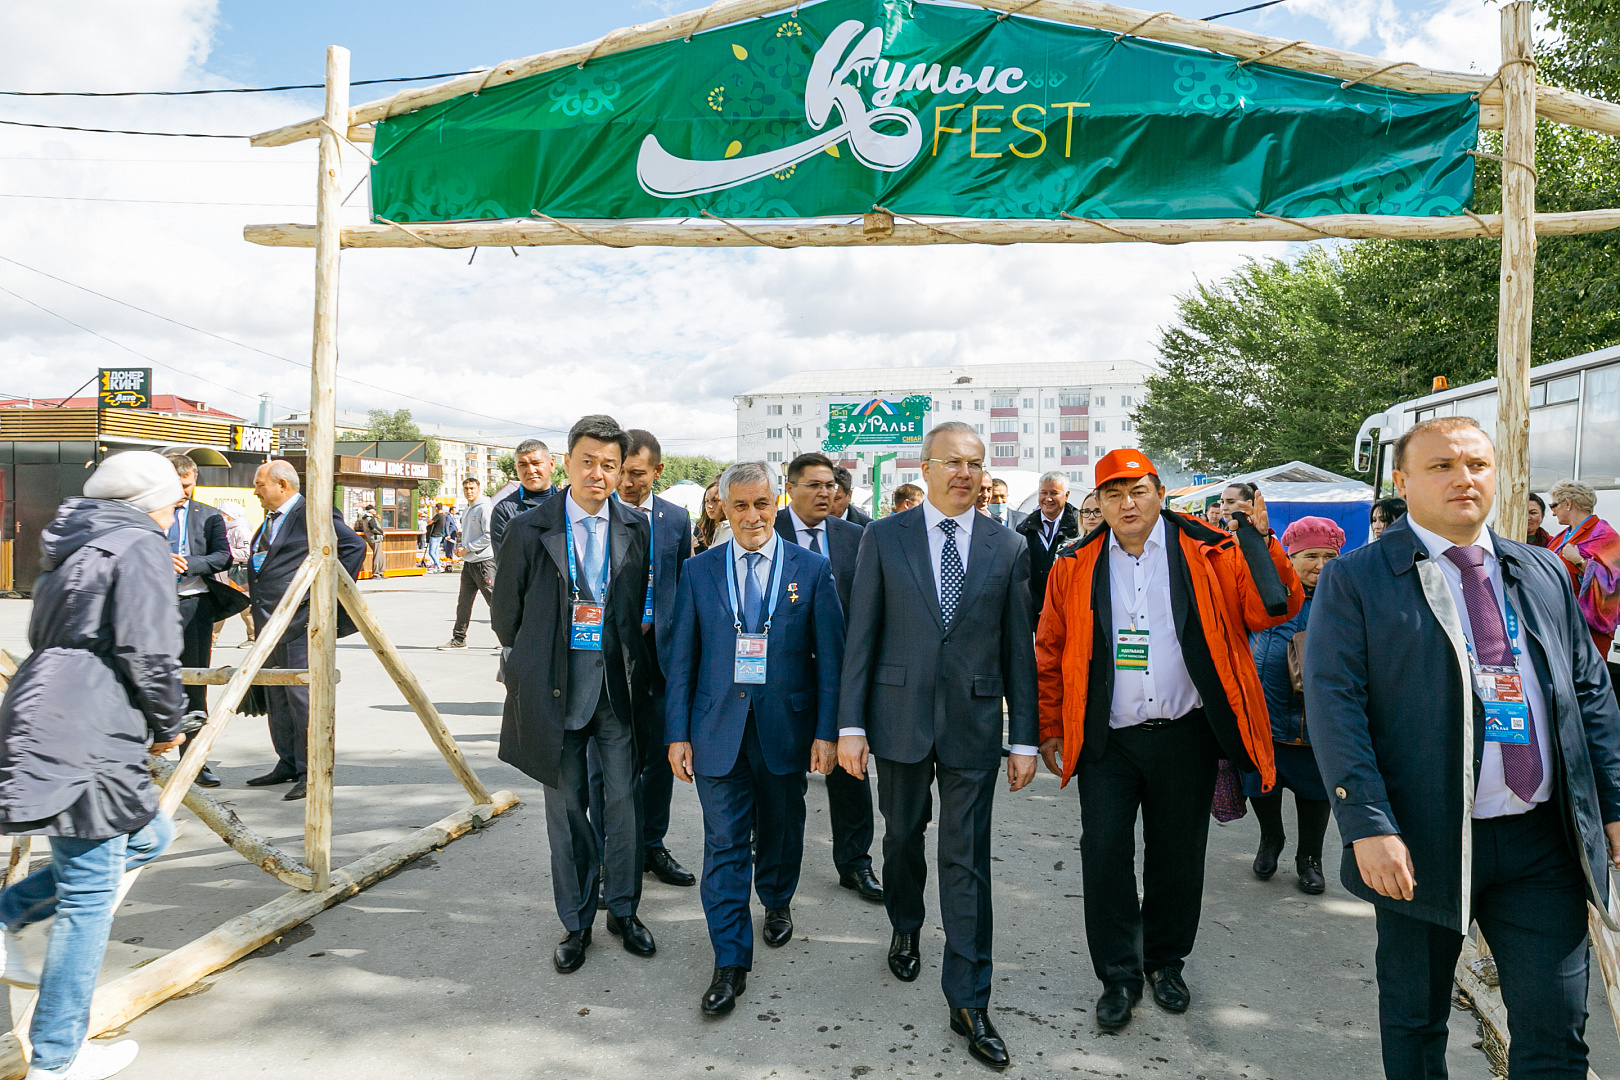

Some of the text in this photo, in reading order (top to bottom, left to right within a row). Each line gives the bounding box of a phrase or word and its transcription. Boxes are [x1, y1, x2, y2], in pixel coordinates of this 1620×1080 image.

[931, 101, 1091, 159] FEST
[110, 371, 145, 380] ДОНЕР
[110, 379, 145, 390] КИНГ
[115, 393, 137, 401] Авто
[838, 415, 915, 433] ЗАУРАЛЬЕ
[242, 426, 273, 438] ДОНЕР
[242, 436, 273, 452] КИНГ
[360, 459, 386, 474] ВОЗЬМИ
[387, 462, 404, 476] КОФЕ
[405, 463, 411, 476] С
